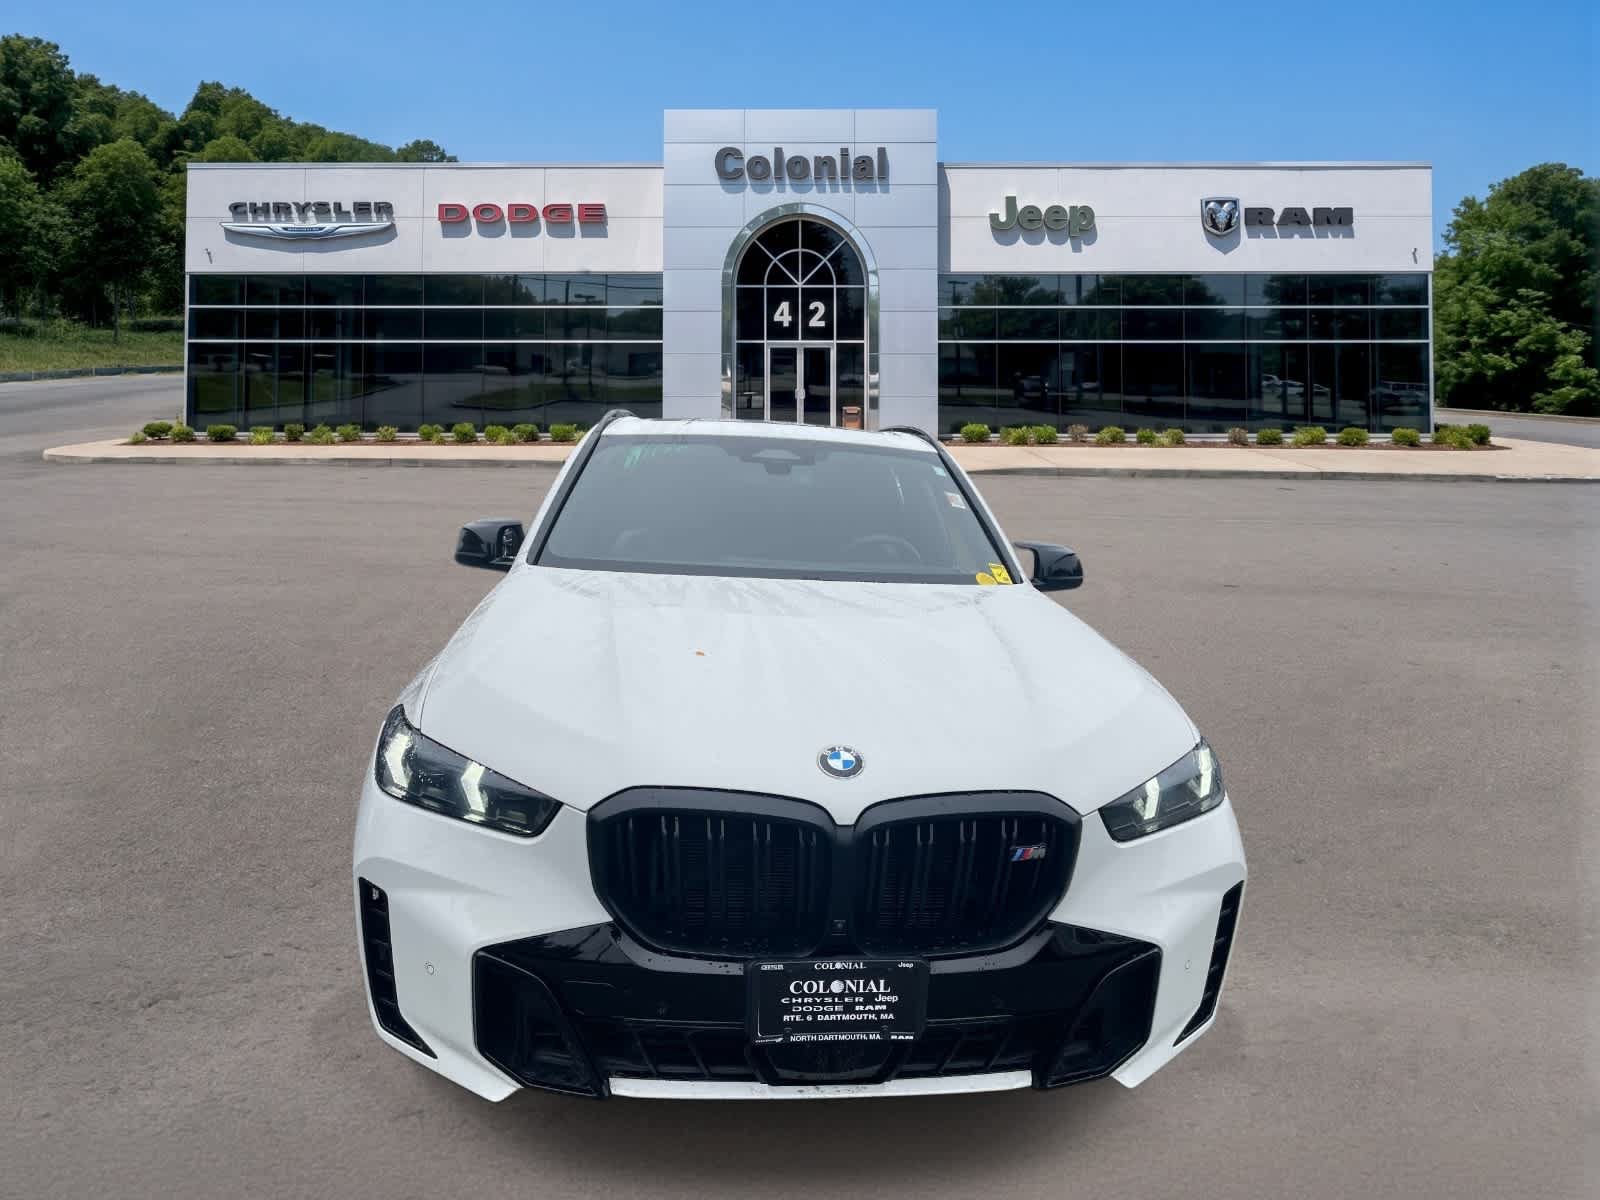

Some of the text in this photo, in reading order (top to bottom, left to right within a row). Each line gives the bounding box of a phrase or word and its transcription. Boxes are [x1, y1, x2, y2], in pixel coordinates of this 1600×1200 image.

[715, 146, 889, 181] Colonial
[229, 201, 394, 215] CHRYSLER
[437, 203, 606, 223] DODGE
[989, 195, 1096, 237] Jeep
[1244, 207, 1354, 226] RAM
[814, 962, 866, 971] COLONIAL
[897, 961, 914, 969] Jeep
[789, 979, 891, 994] COLONIAL
[781, 994, 898, 1004] CHRYSLER Jeep
[783, 1014, 804, 1022] RTE.
[817, 1013, 878, 1021] DARTMOUTH,
[818, 1033, 867, 1041] DARTMOUTH,
